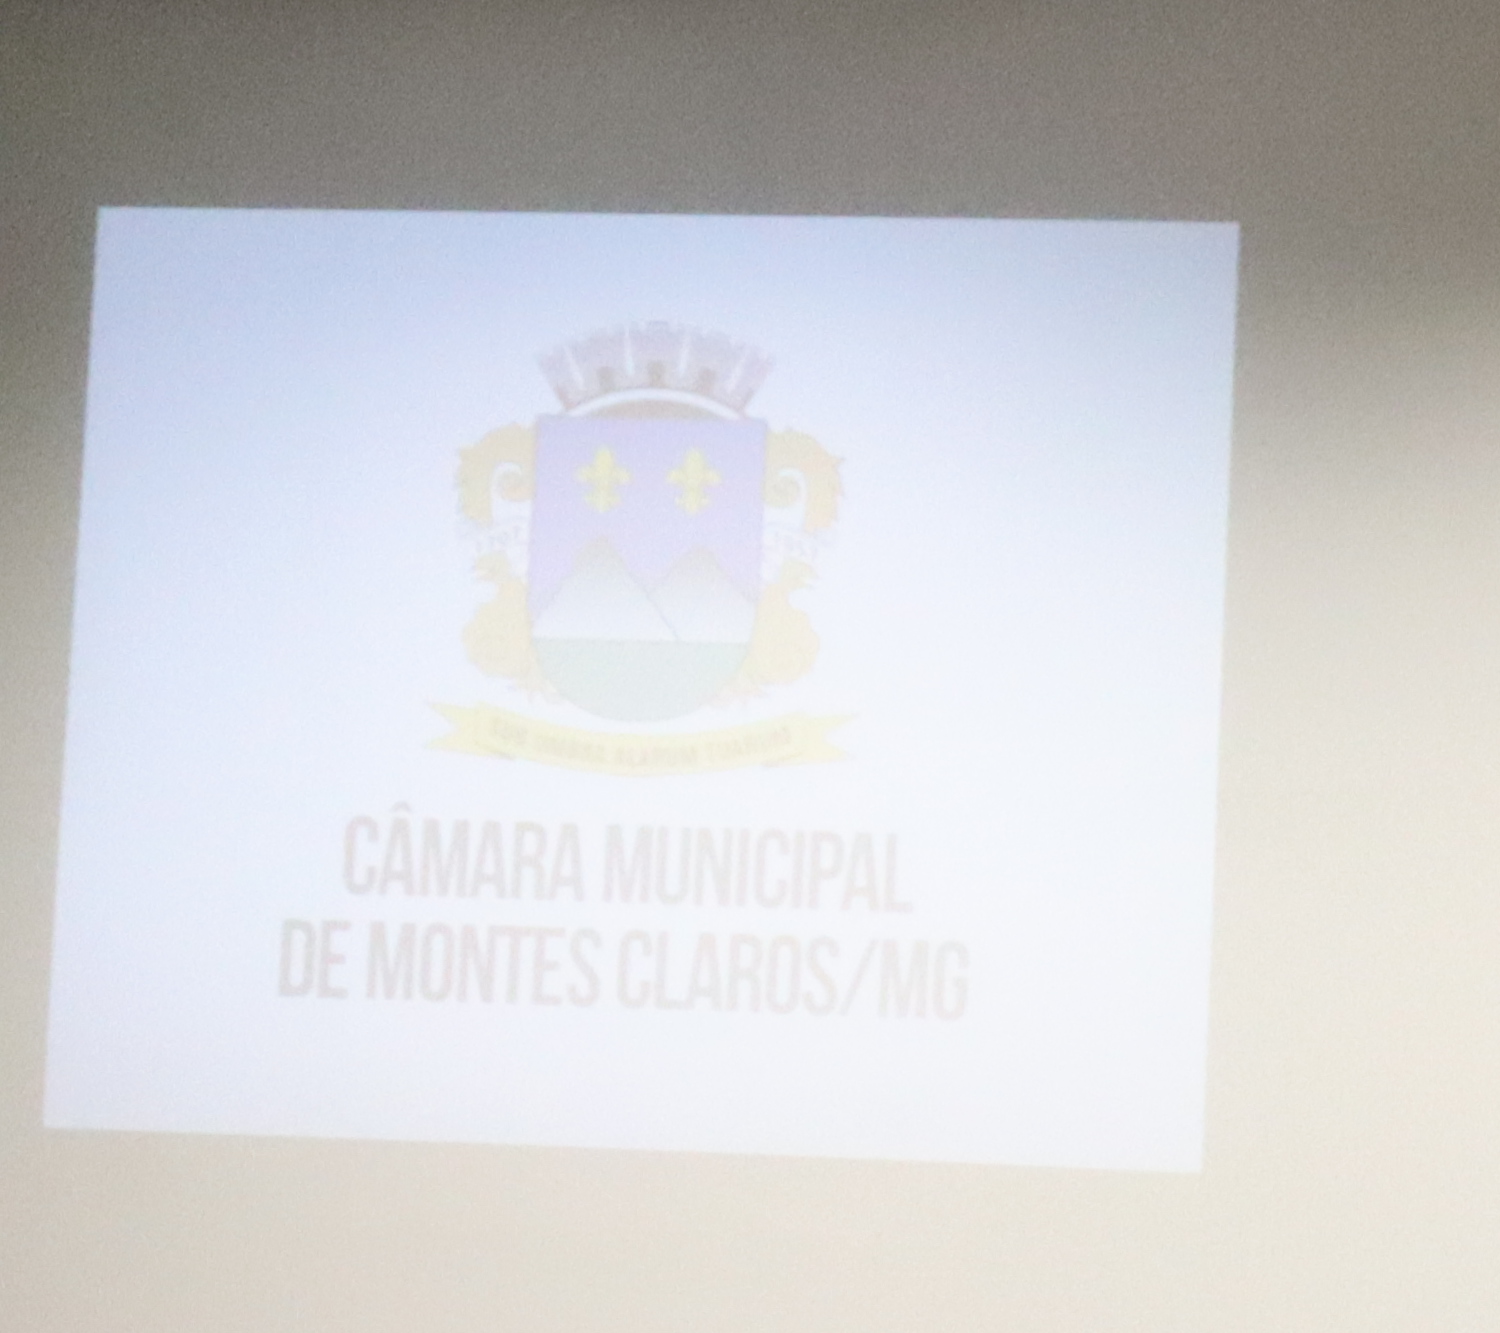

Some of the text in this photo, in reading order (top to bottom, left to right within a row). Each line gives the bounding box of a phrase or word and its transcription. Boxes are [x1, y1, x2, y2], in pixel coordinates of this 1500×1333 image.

[342, 801, 913, 913] CÂMARA MUNICIPAL
[277, 918, 969, 1021] DE MONTES CLAROS/MG
